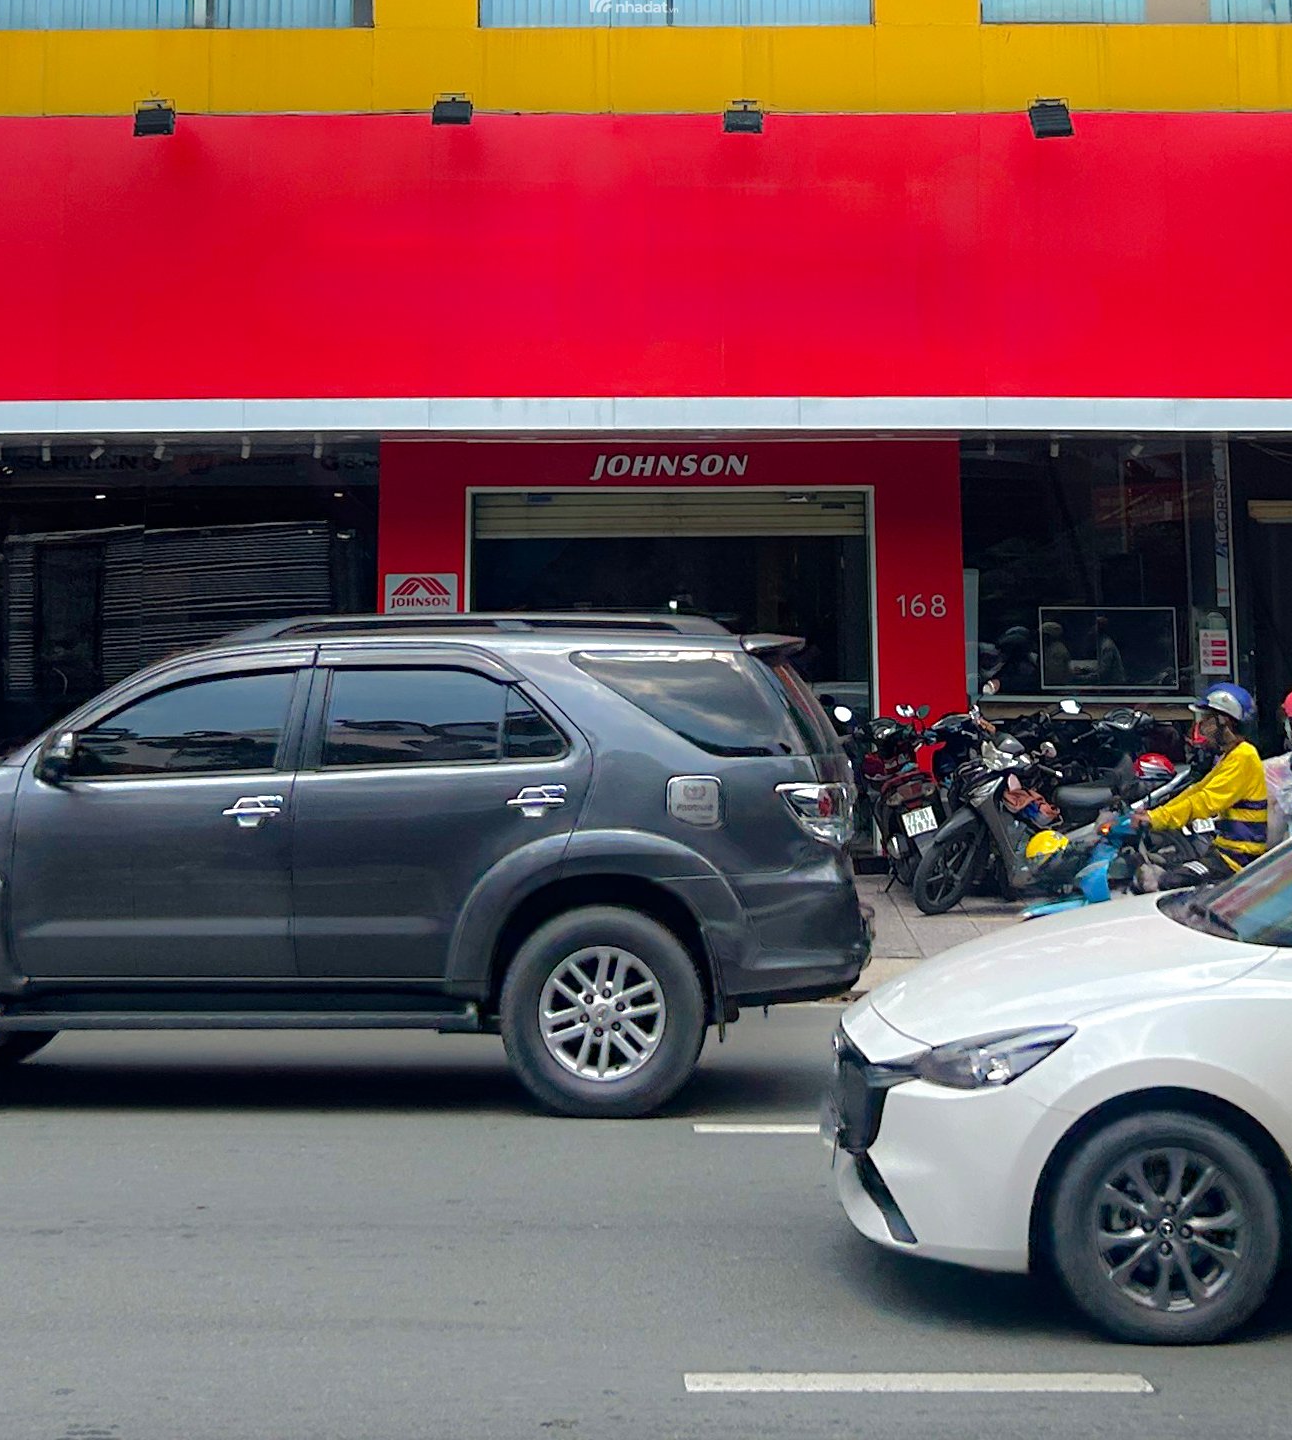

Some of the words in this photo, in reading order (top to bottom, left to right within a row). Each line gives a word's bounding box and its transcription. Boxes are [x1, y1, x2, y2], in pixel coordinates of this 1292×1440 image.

[590, 454, 748, 481] JOHNSON
[391, 597, 450, 609] JOHNSON
[896, 594, 947, 618] 168
